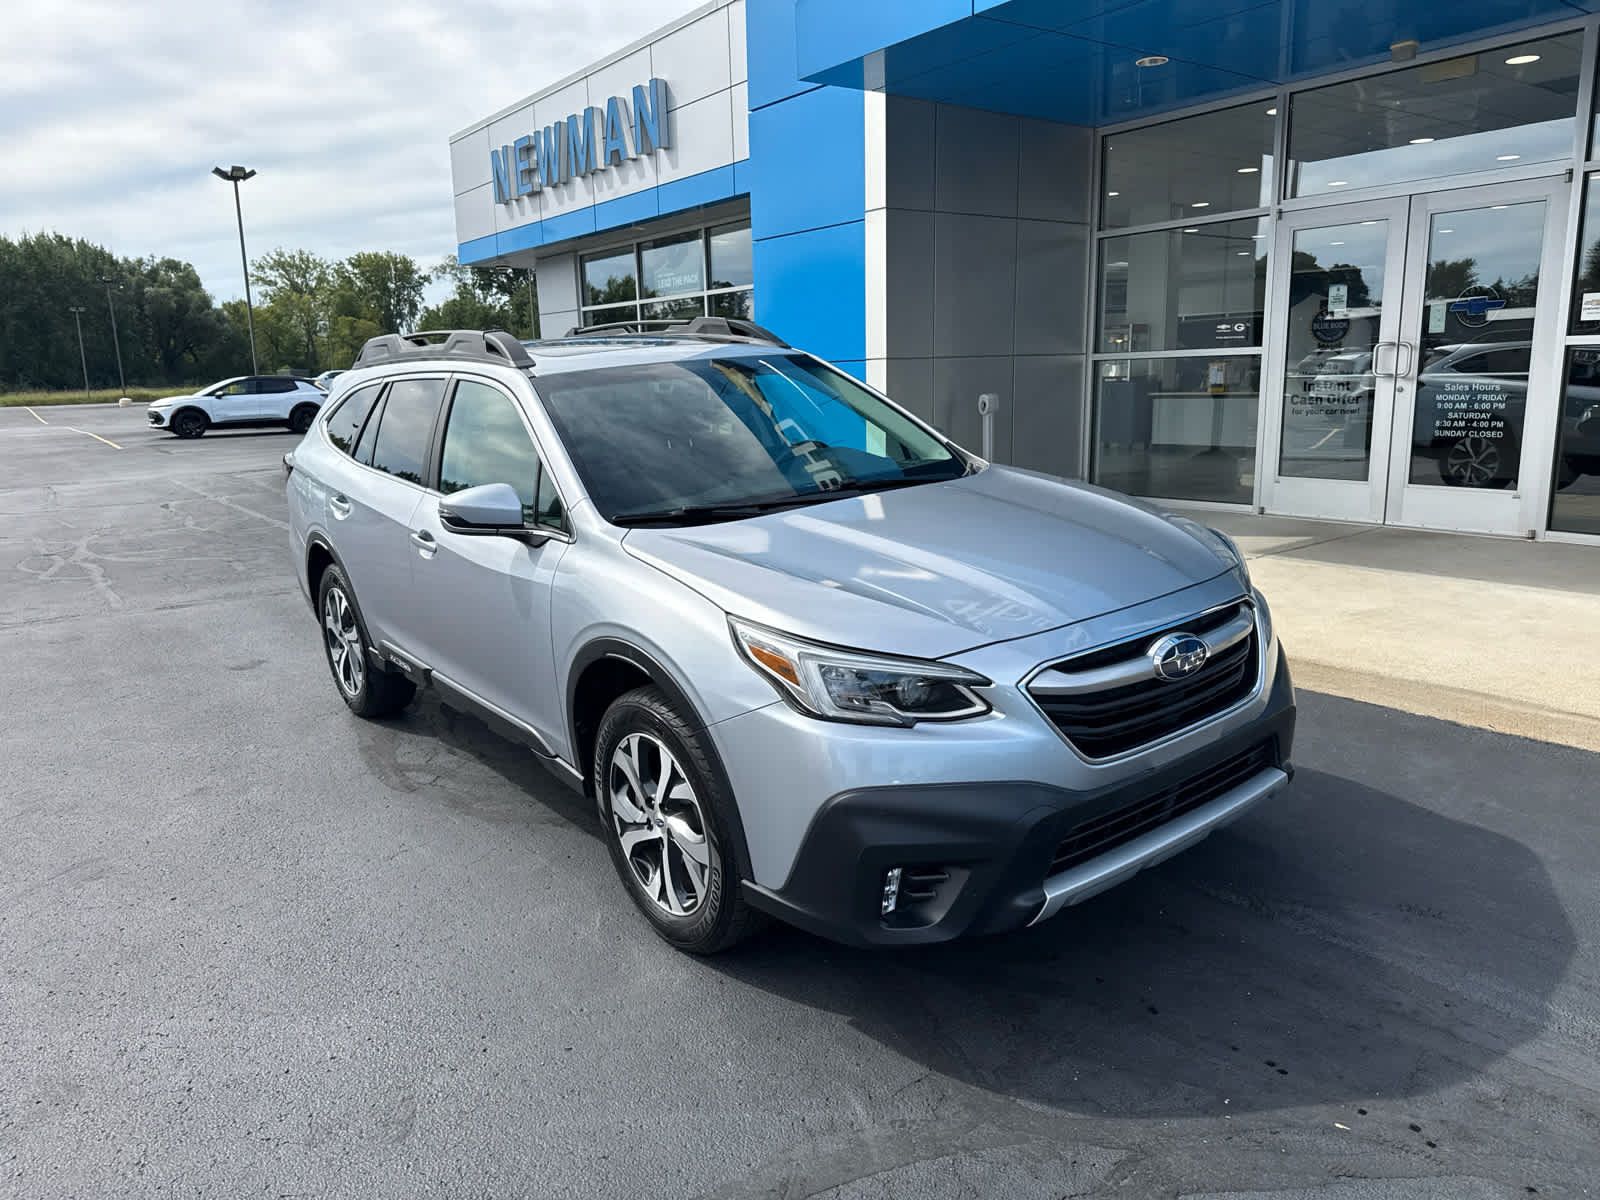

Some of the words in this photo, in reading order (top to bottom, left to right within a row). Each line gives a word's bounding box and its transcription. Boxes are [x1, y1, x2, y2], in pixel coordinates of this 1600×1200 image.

[491, 78, 670, 204] NEWMAN
[672, 275, 684, 287] THE
[1444, 383, 1469, 391] Sales
[1472, 383, 1500, 391] Hours
[1291, 394, 1323, 405] Cash
[1326, 393, 1362, 405] Offer
[1474, 402, 1491, 410] 6:00
[1291, 407, 1304, 415] for
[1305, 408, 1324, 417] your
[1468, 430, 1504, 438] CLOSED
